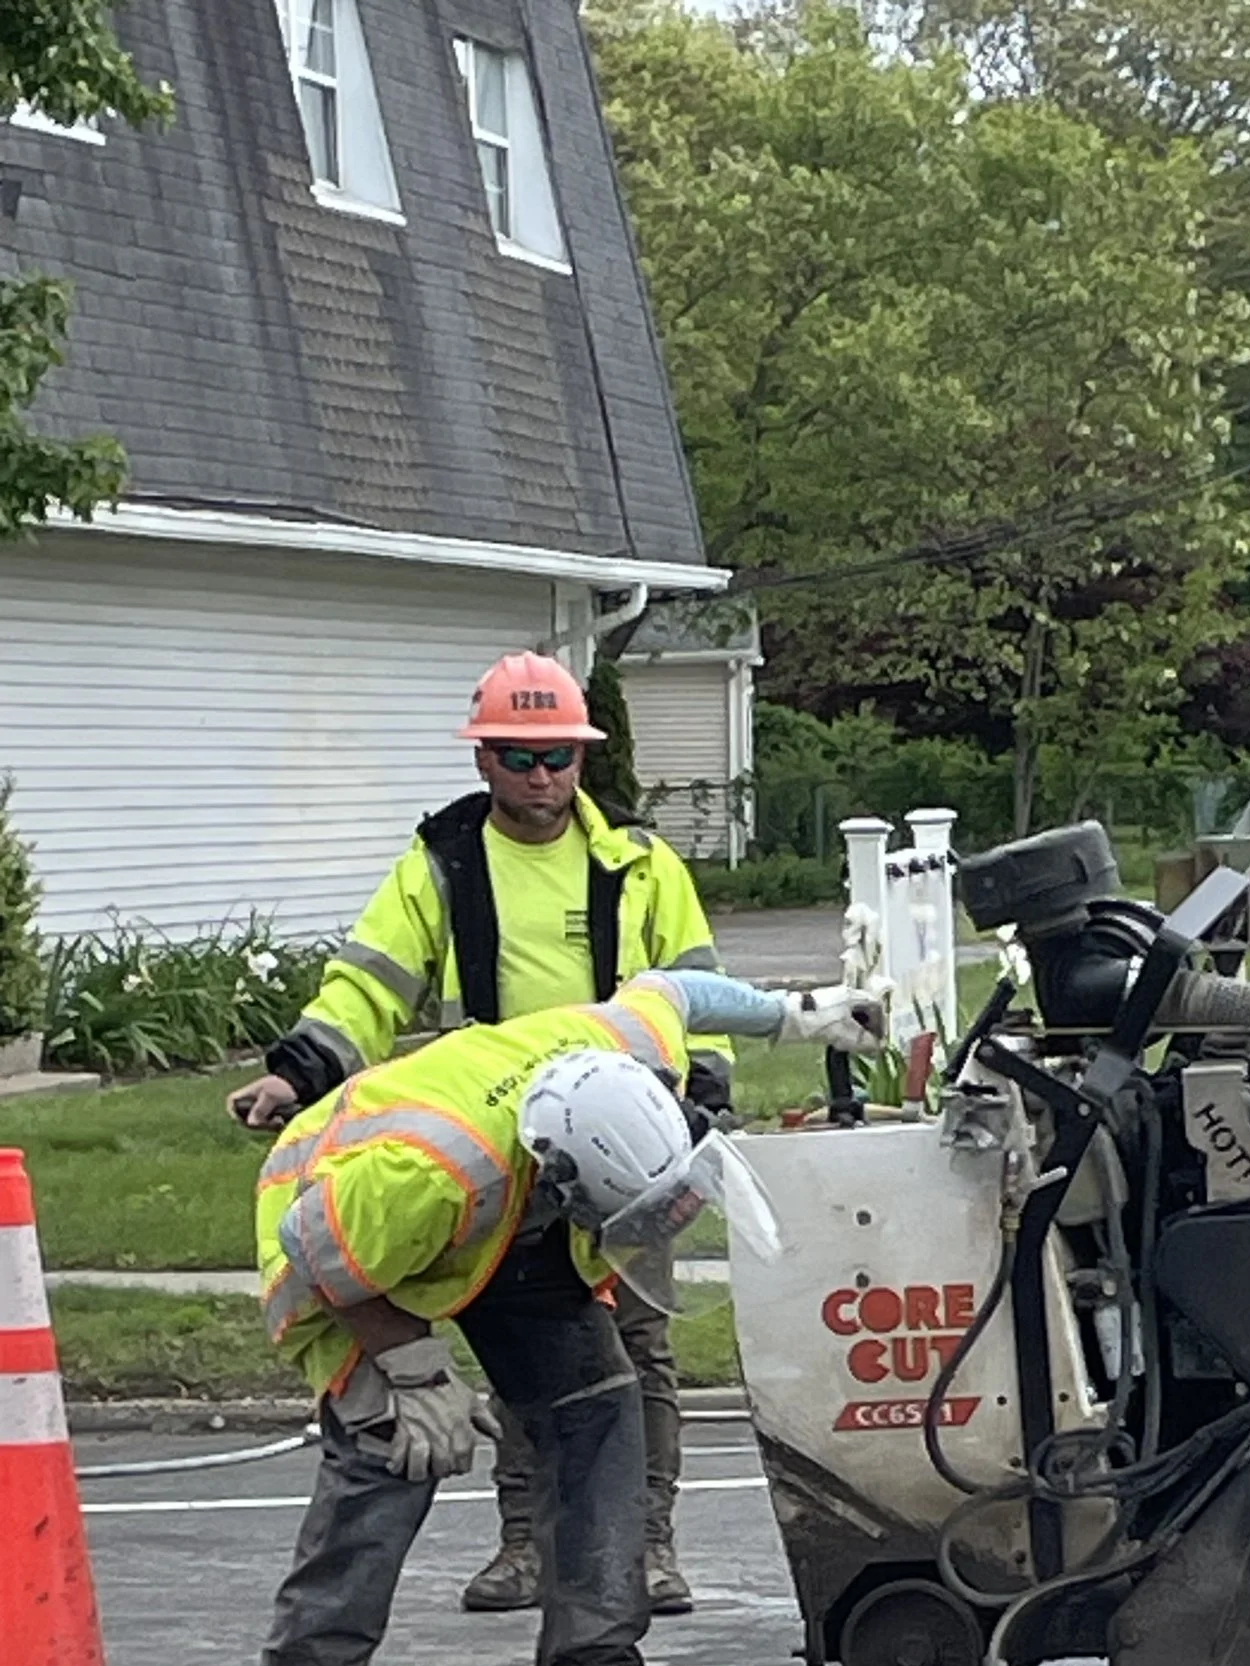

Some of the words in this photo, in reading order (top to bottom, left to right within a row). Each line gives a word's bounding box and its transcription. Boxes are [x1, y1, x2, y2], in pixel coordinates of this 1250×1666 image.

[822, 1284, 974, 1336] CORE
[847, 1335, 965, 1383] CUT
[855, 1402, 953, 1426] CC651
